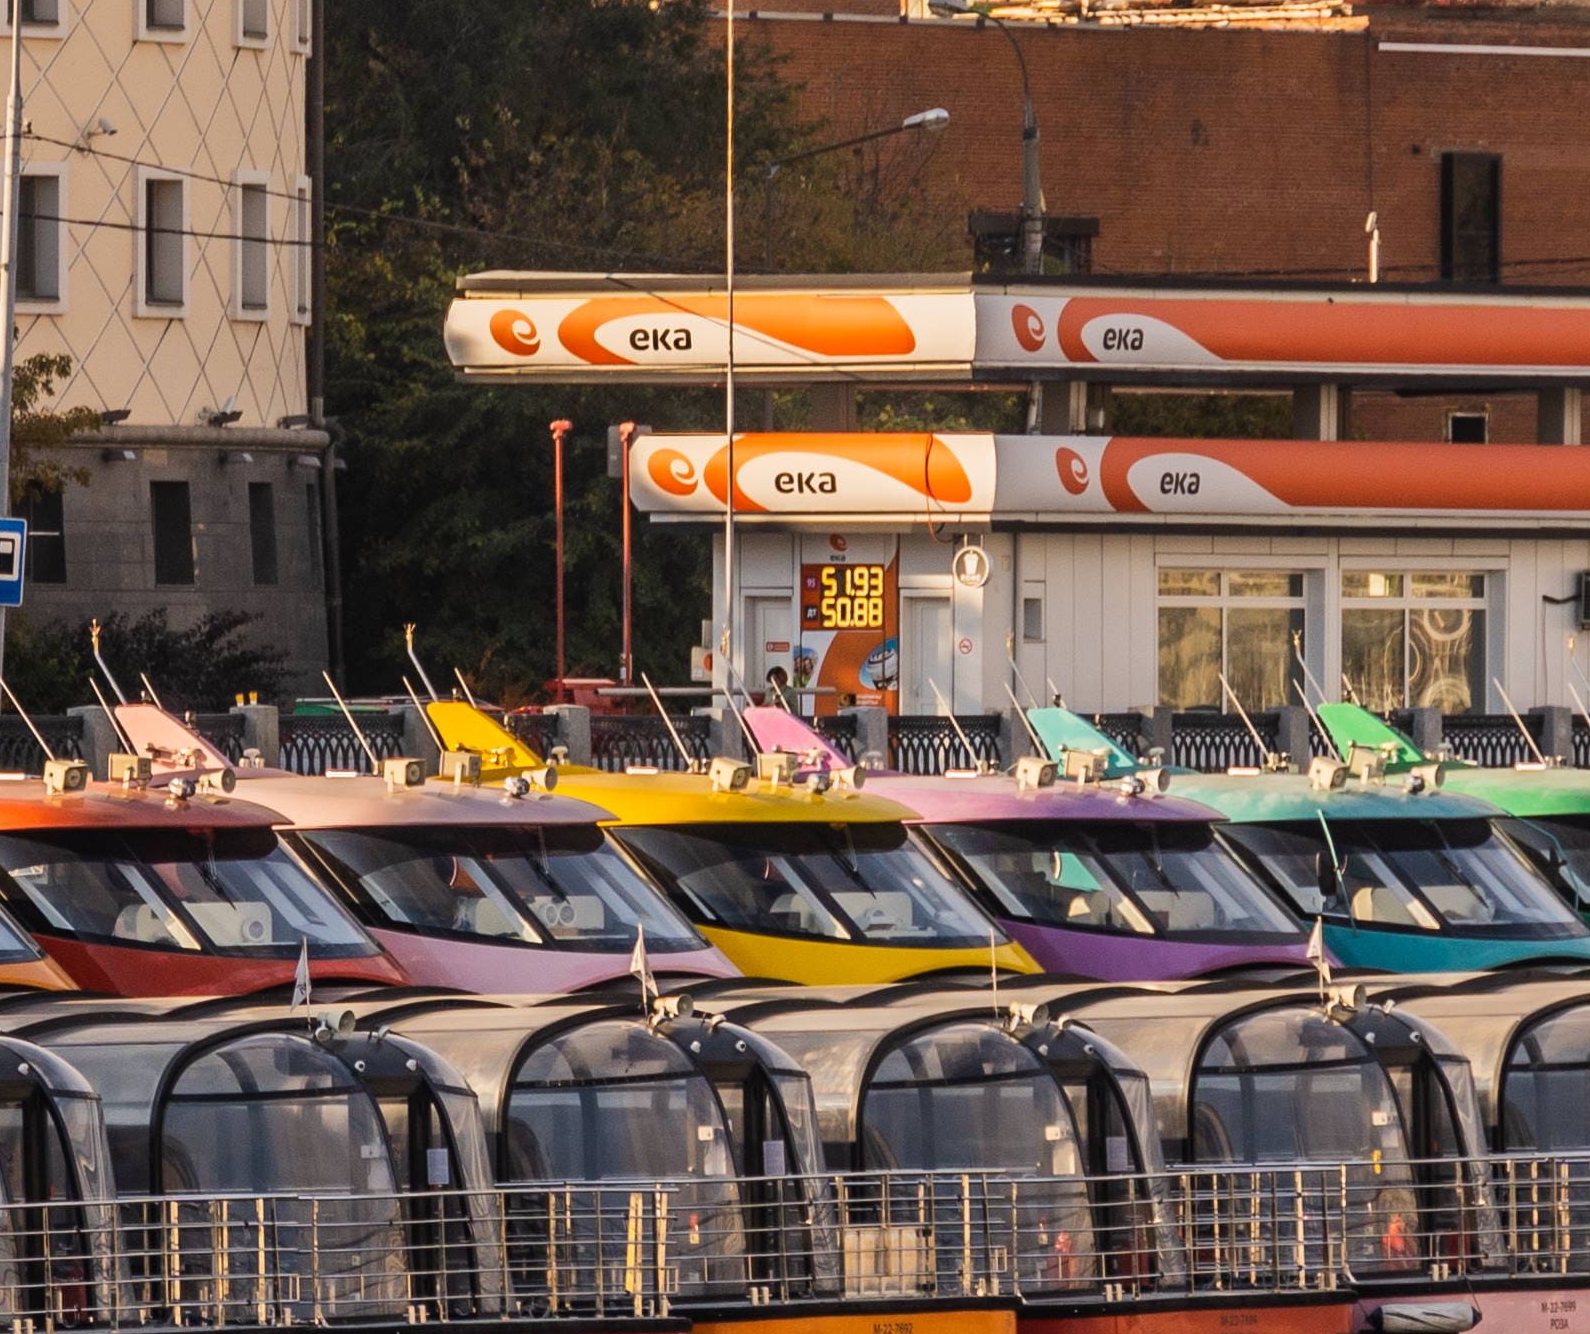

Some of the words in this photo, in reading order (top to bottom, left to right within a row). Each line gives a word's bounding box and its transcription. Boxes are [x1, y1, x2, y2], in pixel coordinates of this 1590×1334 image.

[629, 328, 692, 351] eka
[1103, 328, 1144, 351] eka
[774, 472, 837, 494] eka
[1160, 472, 1200, 495] eka
[821, 566, 884, 597] 51.93
[821, 597, 884, 628] 50.88
[1550, 1318, 1570, 1330] РОЗА
